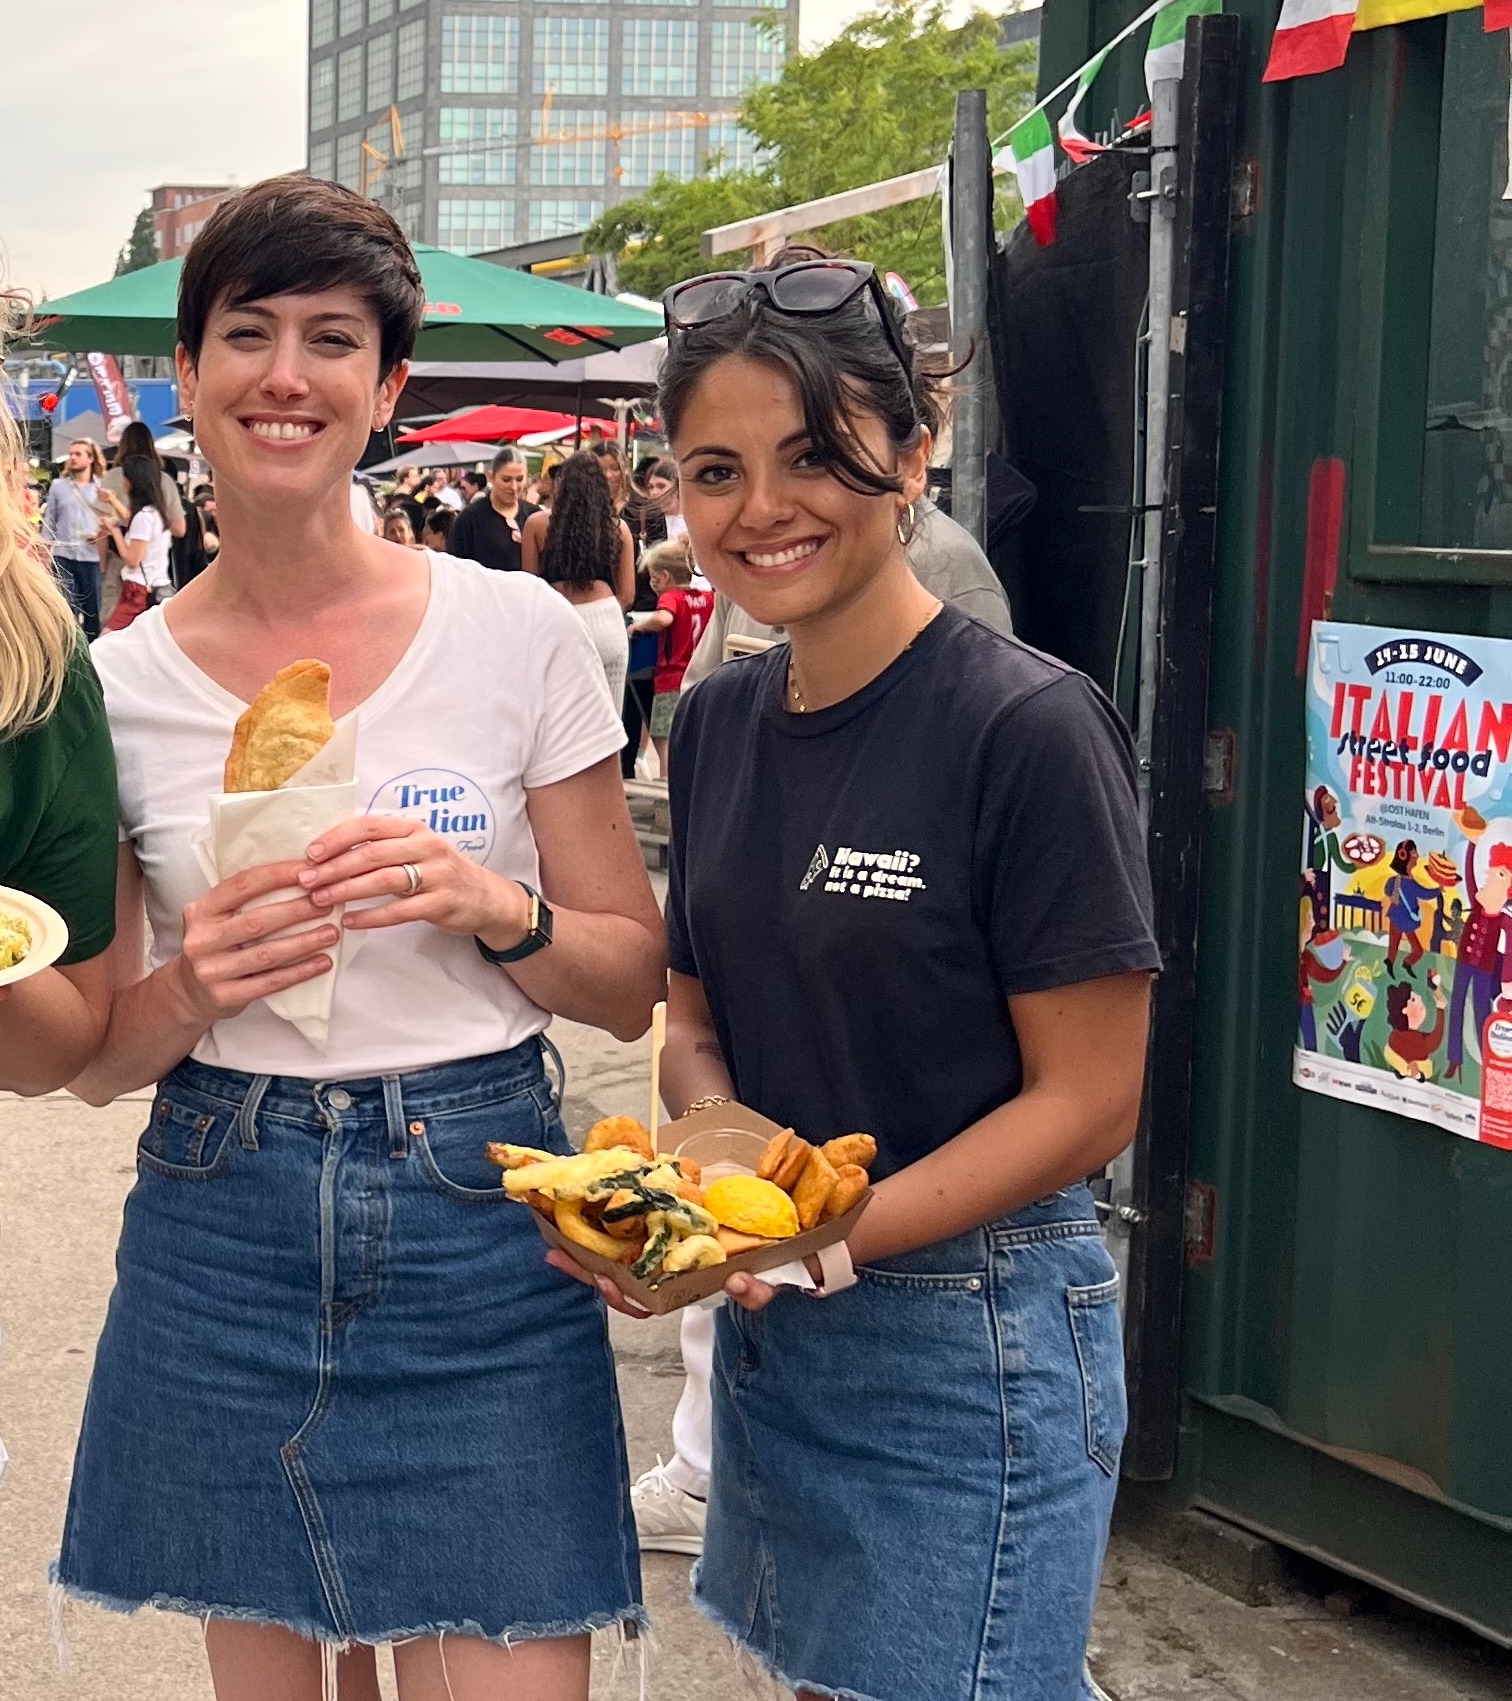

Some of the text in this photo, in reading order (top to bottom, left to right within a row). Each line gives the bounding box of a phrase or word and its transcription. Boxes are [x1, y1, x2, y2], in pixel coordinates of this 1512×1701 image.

[1376, 644, 1468, 675] 14-15 JUNE
[1330, 681, 1512, 764] ITALIAN
[1337, 731, 1492, 778] street food
[394, 784, 465, 809] True
[1349, 756, 1469, 811] FESTIVAL
[422, 808, 488, 834] lian
[824, 881, 847, 893] not
